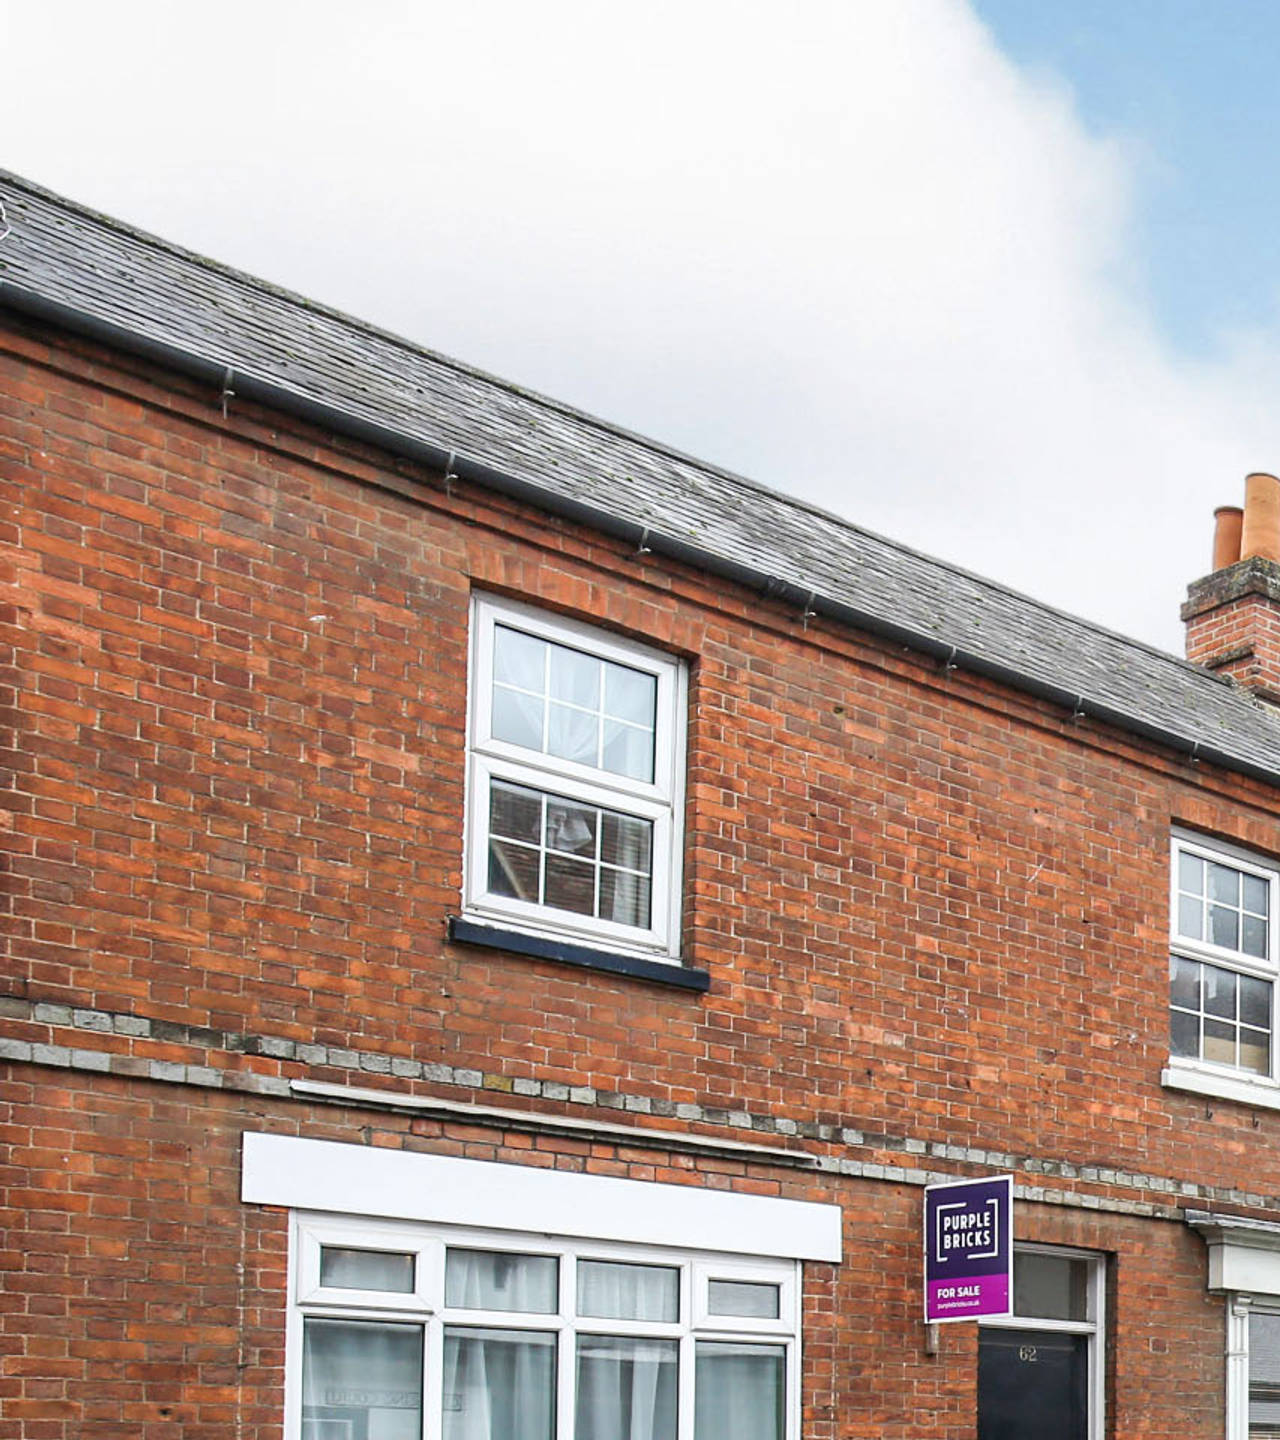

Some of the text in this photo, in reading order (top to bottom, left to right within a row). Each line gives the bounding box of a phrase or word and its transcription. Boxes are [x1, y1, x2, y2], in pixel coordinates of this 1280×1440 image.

[943, 1211, 991, 1231] PURPLE
[943, 1230, 991, 1250] BRICKS
[937, 1285, 981, 1300] FOR SALE
[1019, 1344, 1037, 1362] 62
